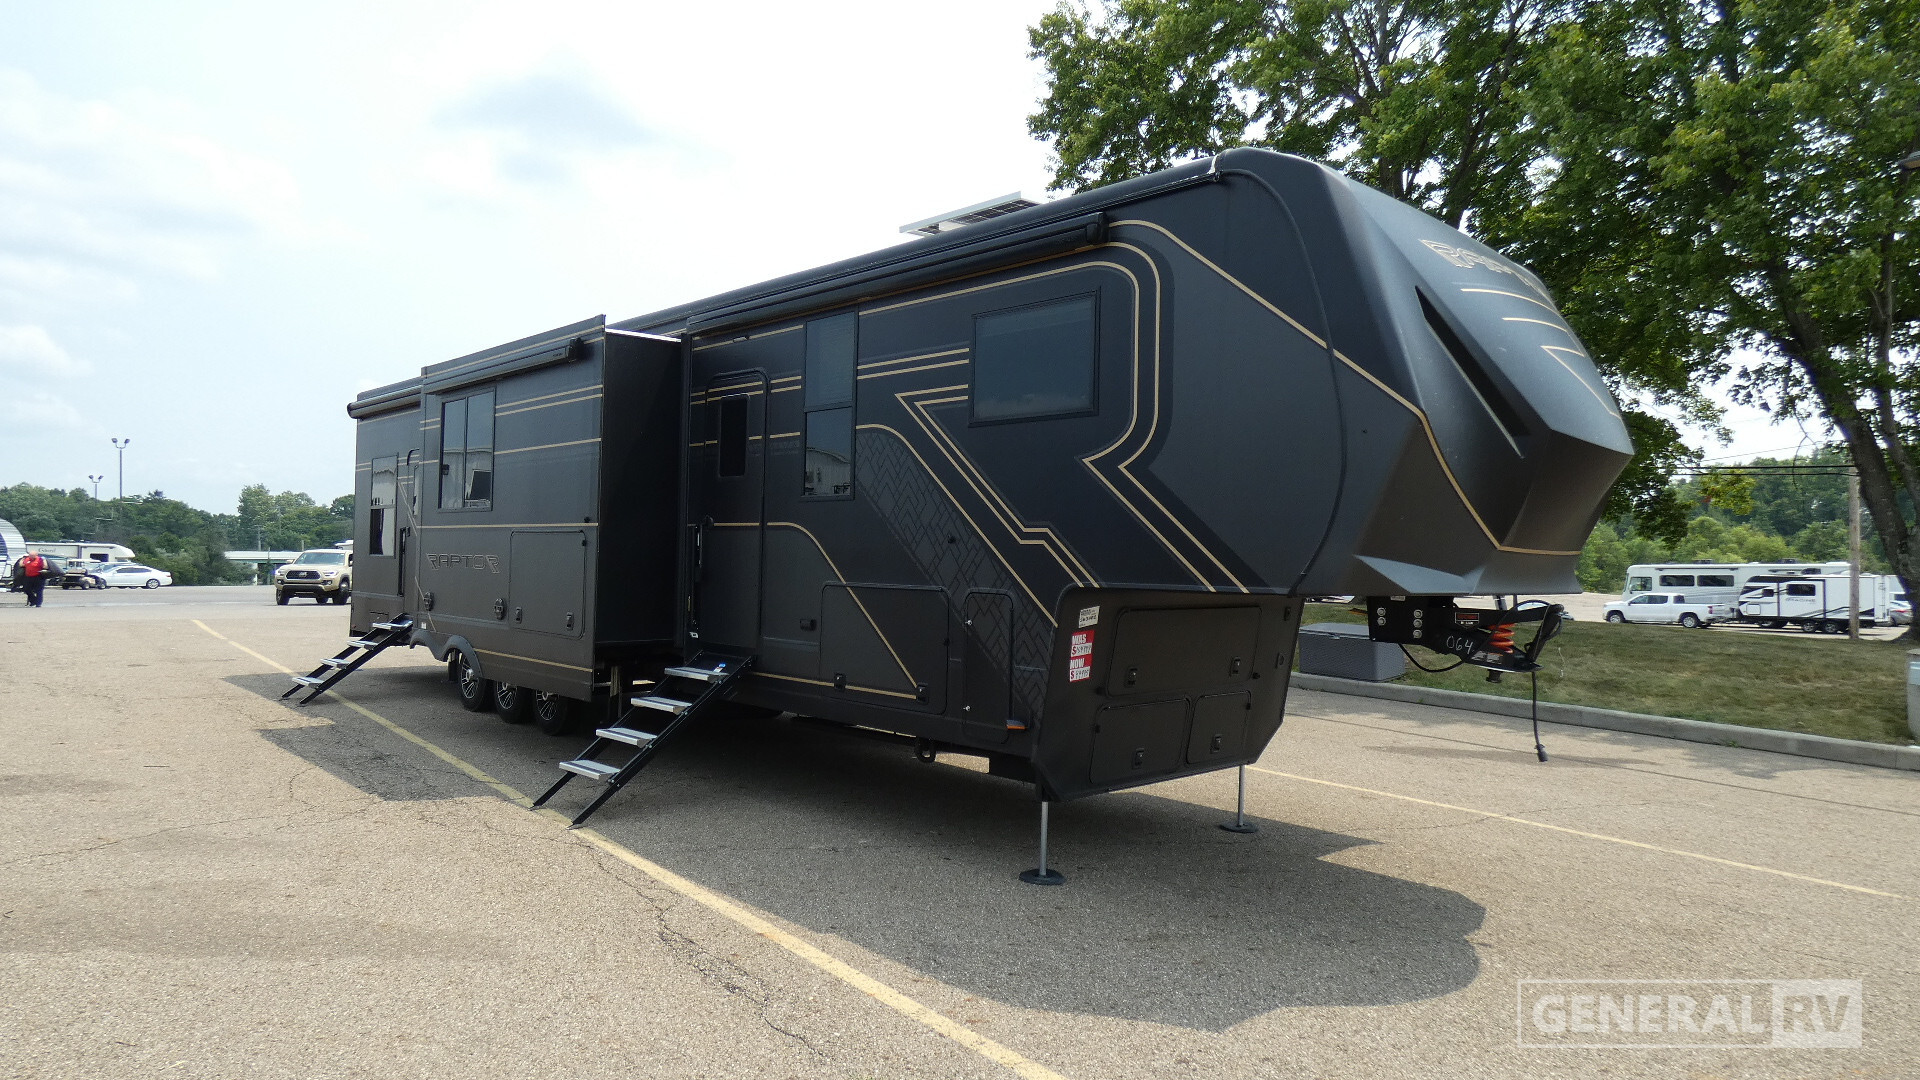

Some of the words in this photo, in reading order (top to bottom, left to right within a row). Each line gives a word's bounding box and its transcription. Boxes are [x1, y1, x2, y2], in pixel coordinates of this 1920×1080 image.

[426, 553, 500, 574] RAPTOR
[1072, 634, 1087, 644] WAS
[1446, 635, 1474, 655] 064
[1070, 658, 1085, 669] NOW
